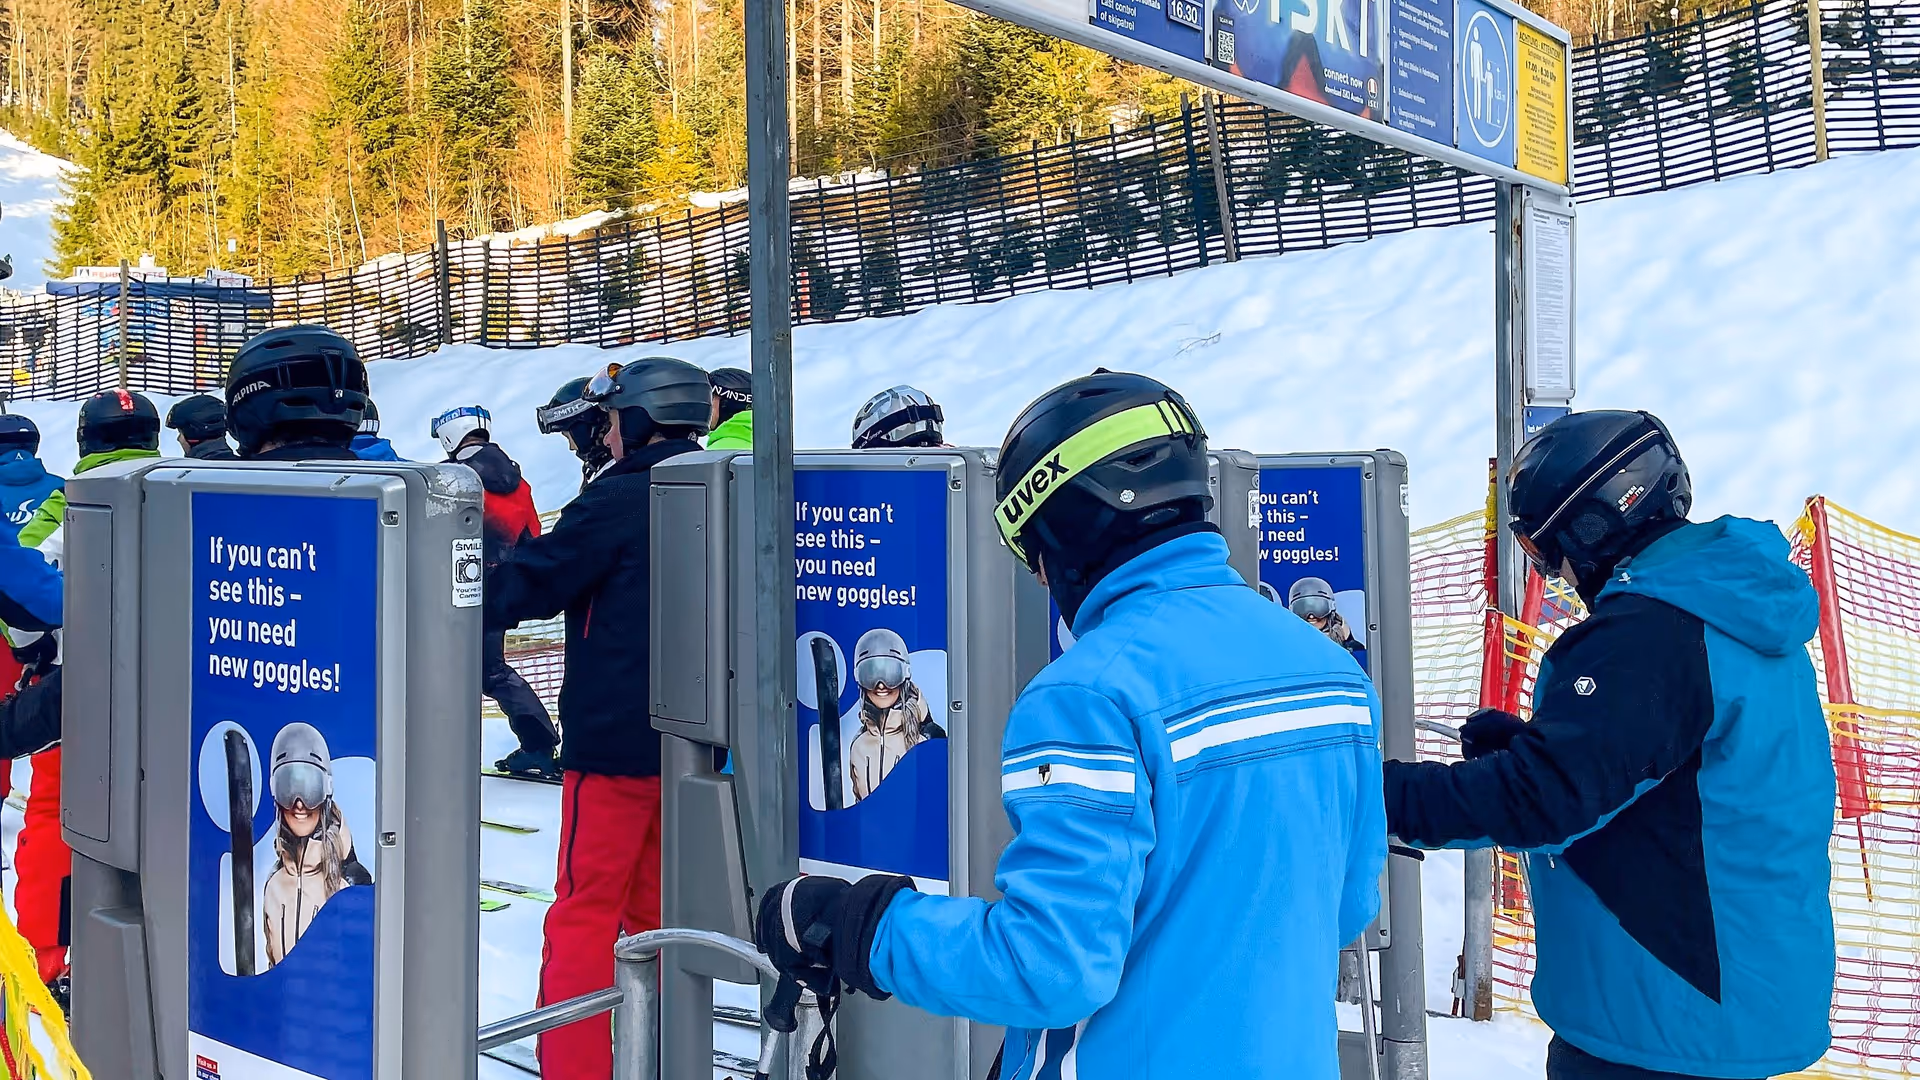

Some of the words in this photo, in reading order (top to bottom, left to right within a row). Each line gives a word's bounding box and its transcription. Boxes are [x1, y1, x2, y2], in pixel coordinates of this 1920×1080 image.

[1115, 1, 1137, 17] control
[1171, 0, 1198, 24] 16.30
[1100, 11, 1107, 20] of
[1108, 13, 1135, 31] skipatrol
[1324, 68, 1350, 85] connect
[1350, 77, 1363, 89] now
[231, 380, 271, 406] ALPINA
[1002, 452, 1069, 524] uvex
[1259, 493, 1277, 505] ou
[1281, 490, 1319, 505] can't
[795, 502, 808, 521] If
[812, 506, 843, 526] you
[848, 503, 894, 523] can't
[1267, 509, 1296, 523] this
[795, 532, 826, 548] see
[831, 529, 865, 549] this
[1268, 528, 1305, 542] need
[210, 536, 223, 564] If
[227, 544, 261, 571] you
[267, 542, 316, 571] can't
[1273, 547, 1339, 564] goggles!
[795, 558, 826, 578] you
[831, 557, 876, 577] need
[209, 579, 242, 602] see
[248, 577, 284, 607] this
[796, 585, 832, 601] new
[837, 584, 916, 609] goggles!
[209, 616, 242, 644] you
[248, 619, 296, 647] need
[209, 654, 248, 679] new
[253, 659, 340, 693] goggles!
